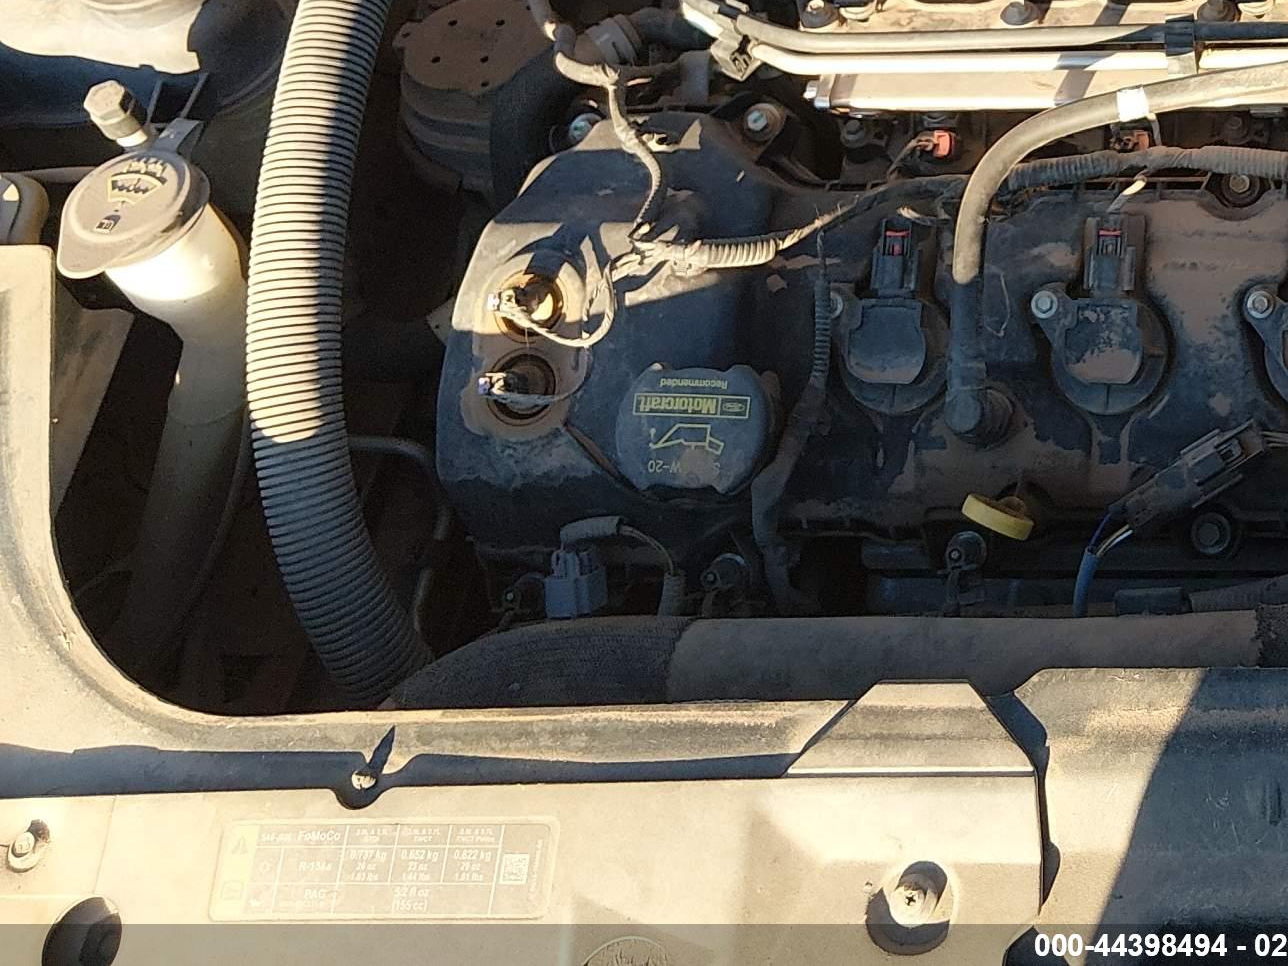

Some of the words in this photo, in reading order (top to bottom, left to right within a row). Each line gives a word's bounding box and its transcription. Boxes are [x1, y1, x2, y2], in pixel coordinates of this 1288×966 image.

[659, 378, 728, 389] Recommended
[638, 396, 717, 414] Motorcraft
[648, 460, 688, 474] W-20
[298, 830, 341, 842] FoMoCo
[427, 849, 439, 862] kg
[479, 849, 492, 862] kg
[304, 889, 326, 899] PAG
